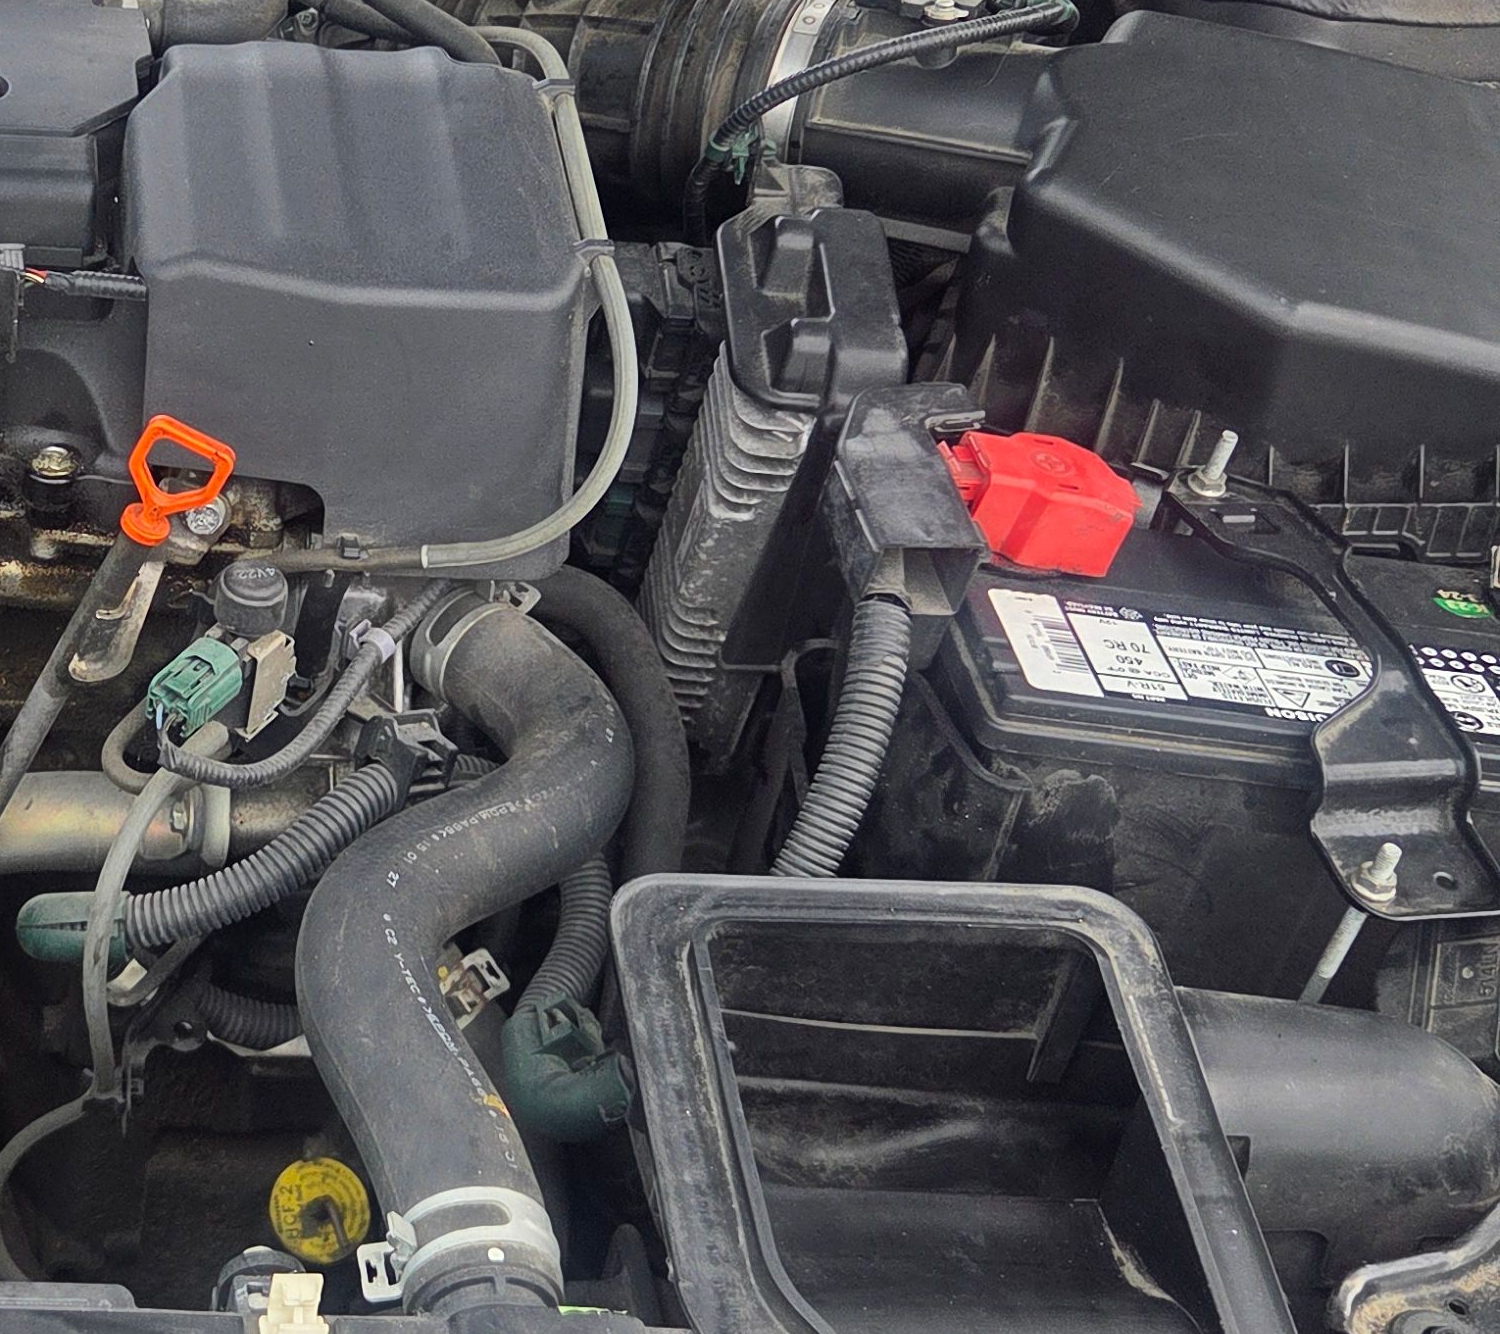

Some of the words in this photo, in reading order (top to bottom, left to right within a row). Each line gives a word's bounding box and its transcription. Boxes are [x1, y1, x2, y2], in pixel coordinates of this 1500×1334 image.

[1102, 638, 1127, 653] RC
[1129, 642, 1152, 656] 70
[1115, 654, 1144, 667] 450
